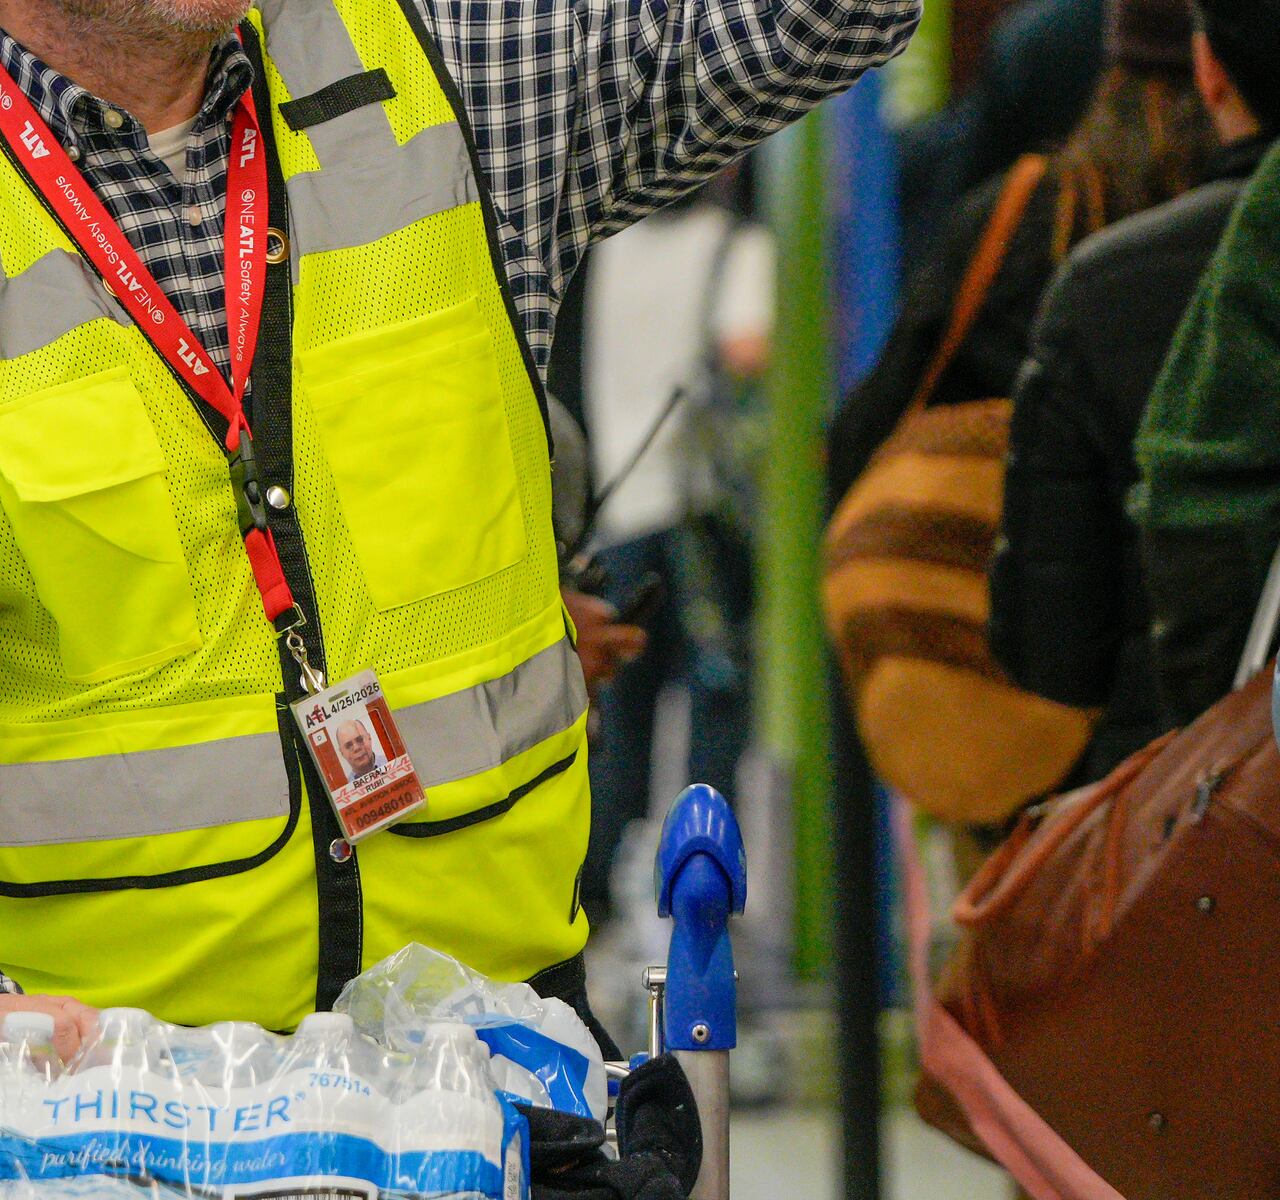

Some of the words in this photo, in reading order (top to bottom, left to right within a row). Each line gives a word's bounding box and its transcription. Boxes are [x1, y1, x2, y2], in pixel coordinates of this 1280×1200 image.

[19, 120, 51, 159] ATL
[240, 127, 257, 168] ATL
[55, 175, 91, 222] Always
[88, 221, 119, 264] Safety
[240, 260, 253, 306] Safety
[235, 307, 251, 362] Always
[176, 337, 210, 376] ATL
[43, 1087, 293, 1132] THIRSTER
[42, 1138, 131, 1174] purified
[132, 1139, 228, 1180] drinking
[233, 1150, 287, 1173] water
